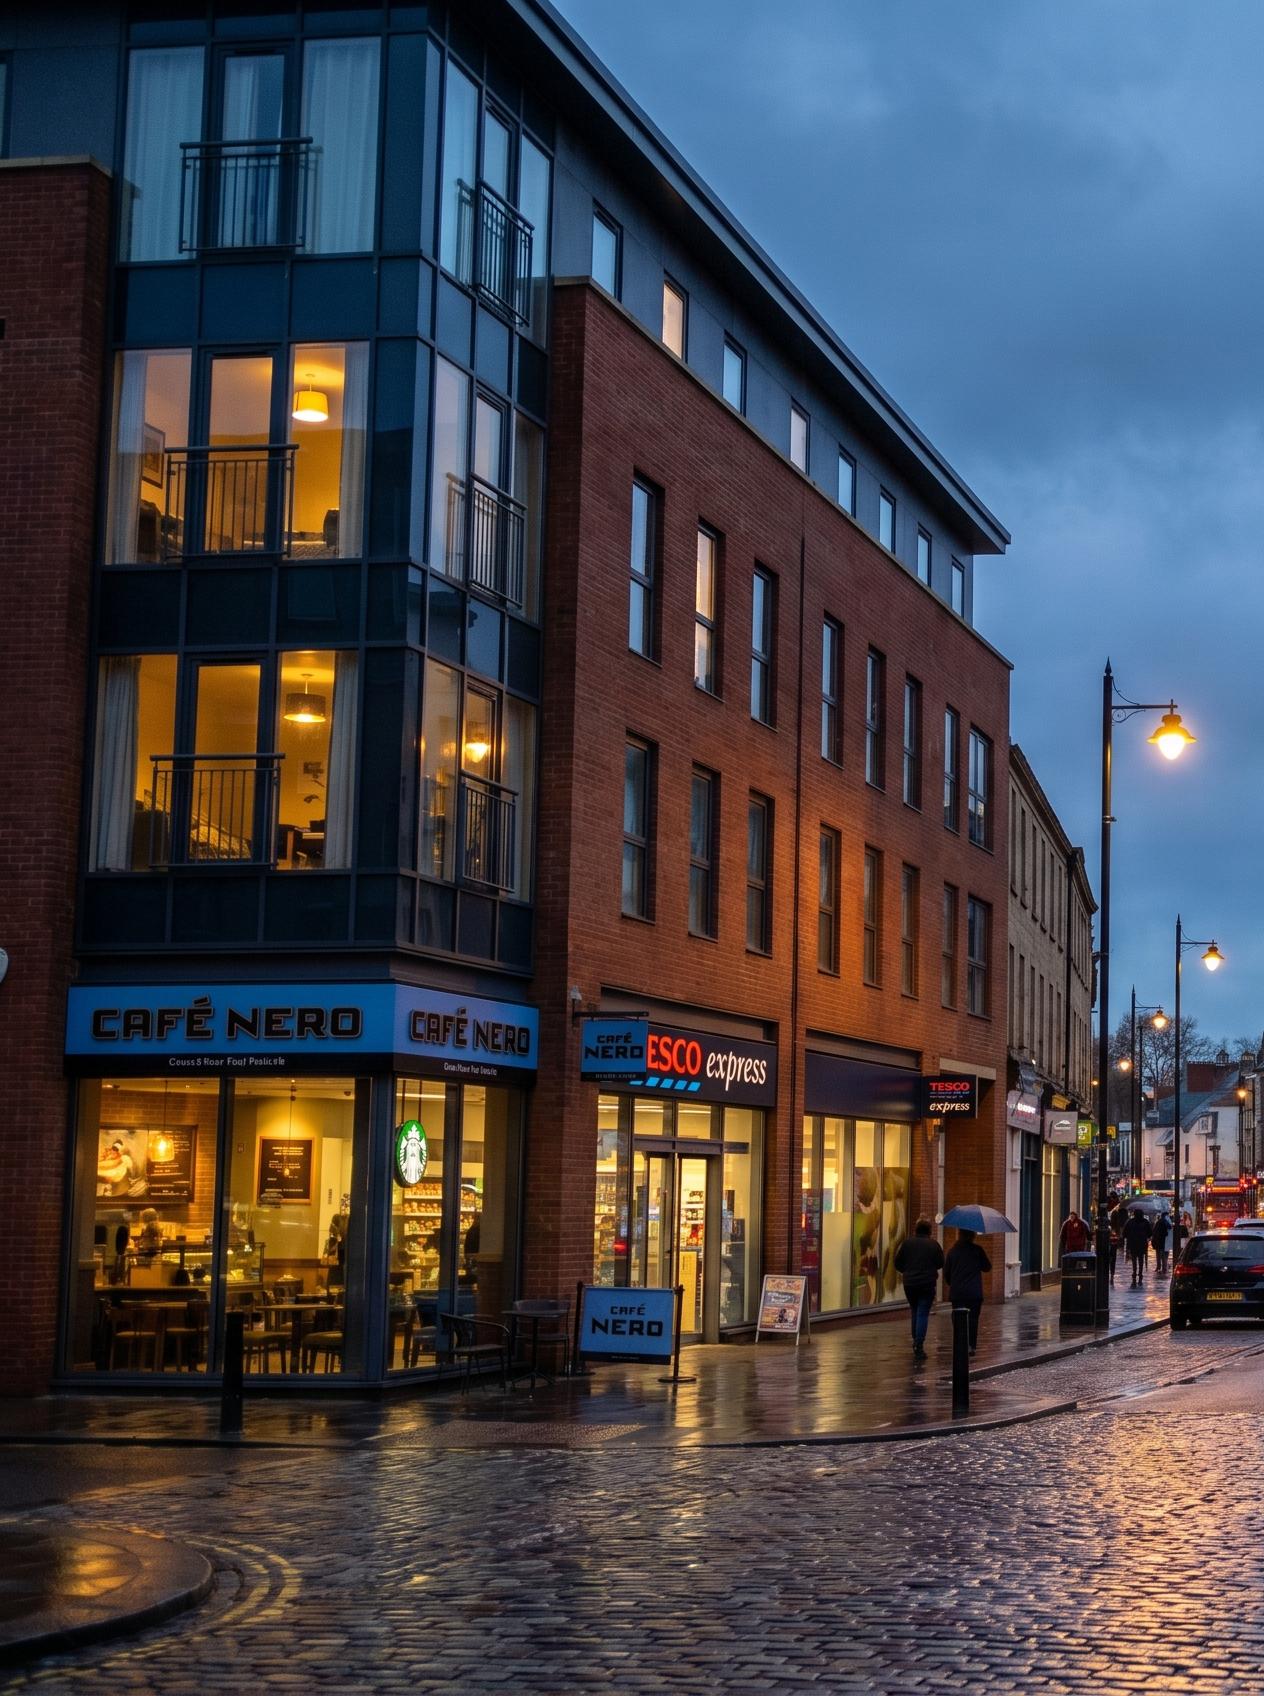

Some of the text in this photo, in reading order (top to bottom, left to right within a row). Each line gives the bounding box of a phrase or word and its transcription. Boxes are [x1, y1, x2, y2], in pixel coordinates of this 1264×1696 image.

[90, 995, 364, 1041] CAFÉ NERO
[410, 1006, 531, 1056] CAFÉ NERO
[597, 1032, 632, 1044] CAFÉ
[585, 1045, 644, 1059] NERO
[647, 1034, 767, 1091] ESCO express
[929, 1082, 970, 1091] TESCO
[930, 1102, 970, 1114] express
[610, 1303, 646, 1316] CAFÉ
[592, 1317, 664, 1337] NERO
